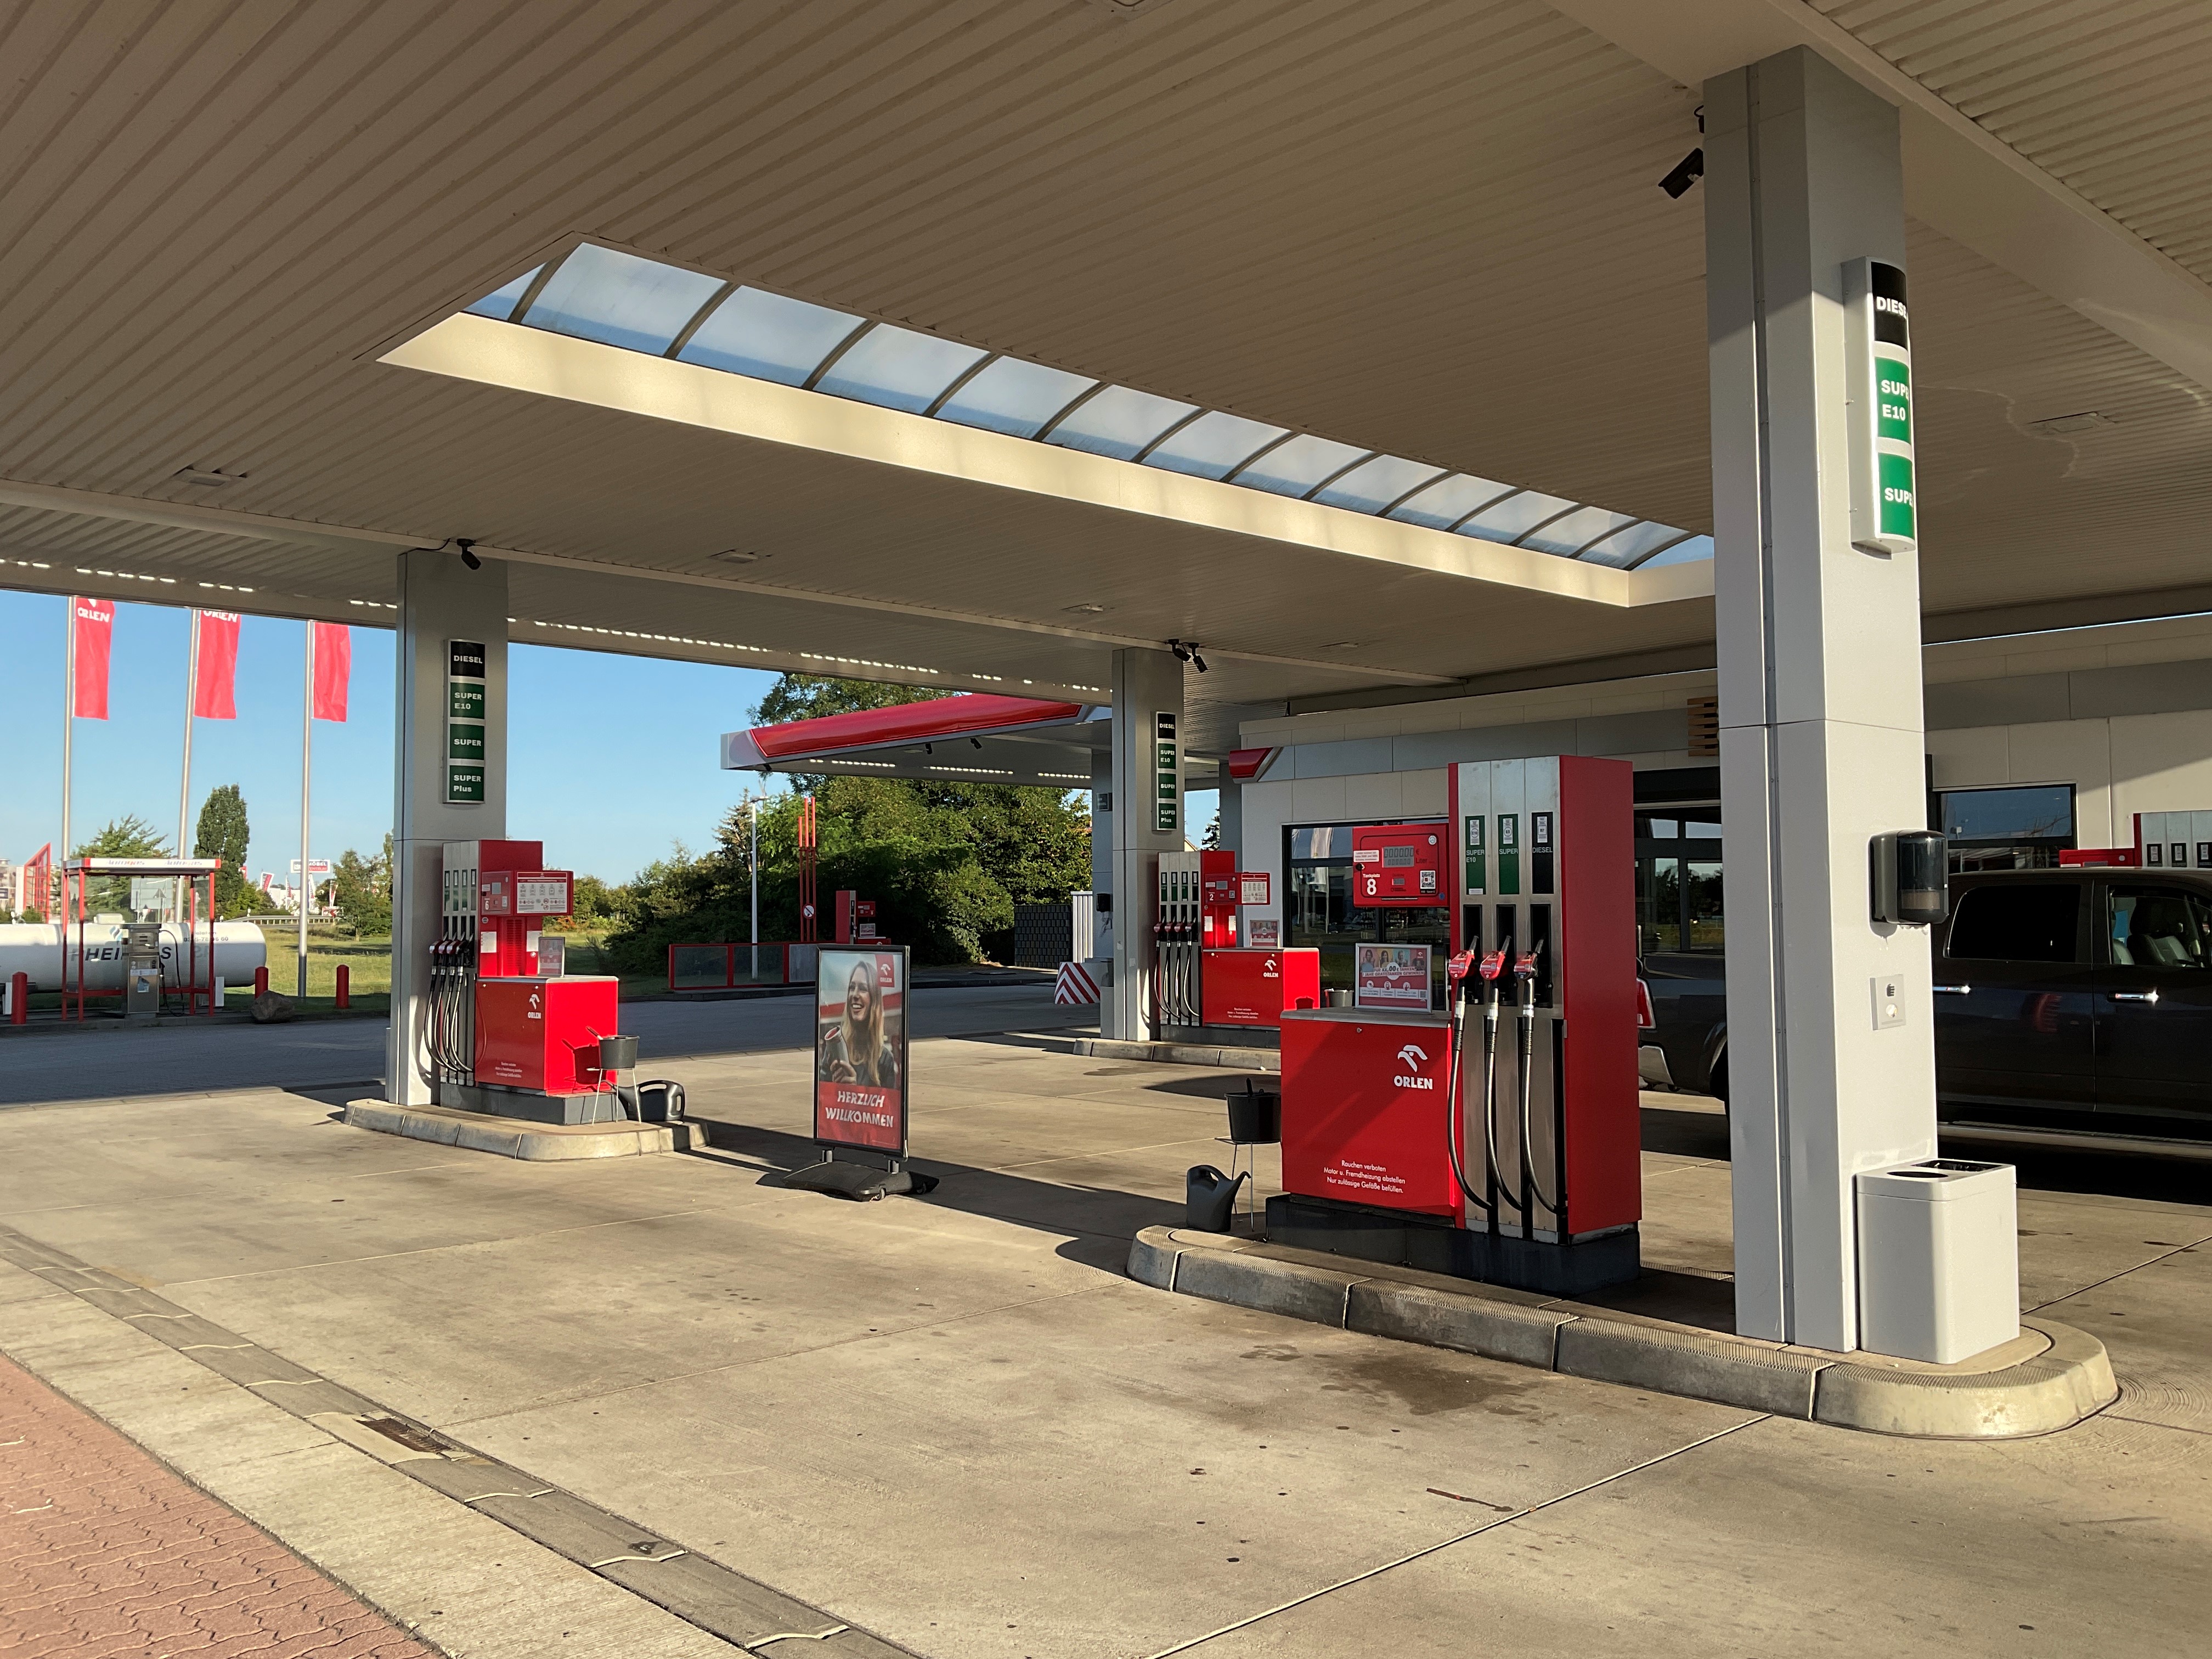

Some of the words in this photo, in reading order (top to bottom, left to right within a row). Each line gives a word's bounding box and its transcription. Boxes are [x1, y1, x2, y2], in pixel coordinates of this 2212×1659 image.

[1876, 296, 1907, 320] DIESE
[1881, 380, 1909, 401] SUPE
[1882, 404, 1906, 421] E10
[1884, 487, 1913, 507] SUPE
[77, 607, 110, 623] ORLEN
[453, 655, 483, 664] DIESEL
[454, 692, 482, 701] SUPER
[1367, 878, 1377, 895] 8
[485, 900, 489, 910] 6
[1393, 1075, 1433, 1090] ORLEN
[837, 1091, 885, 1108] HERZLICH
[825, 1107, 894, 1128] WILLKOMMEN
[1341, 1160, 1363, 1169] Rauchen
[1364, 1164, 1386, 1172] verboten
[1338, 1178, 1360, 1188] zulässige
[1361, 1181, 1380, 1190] Gefäße
[1346, 1170, 1381, 1182] Fremdheizung
[1383, 1175, 1406, 1184] abstellen
